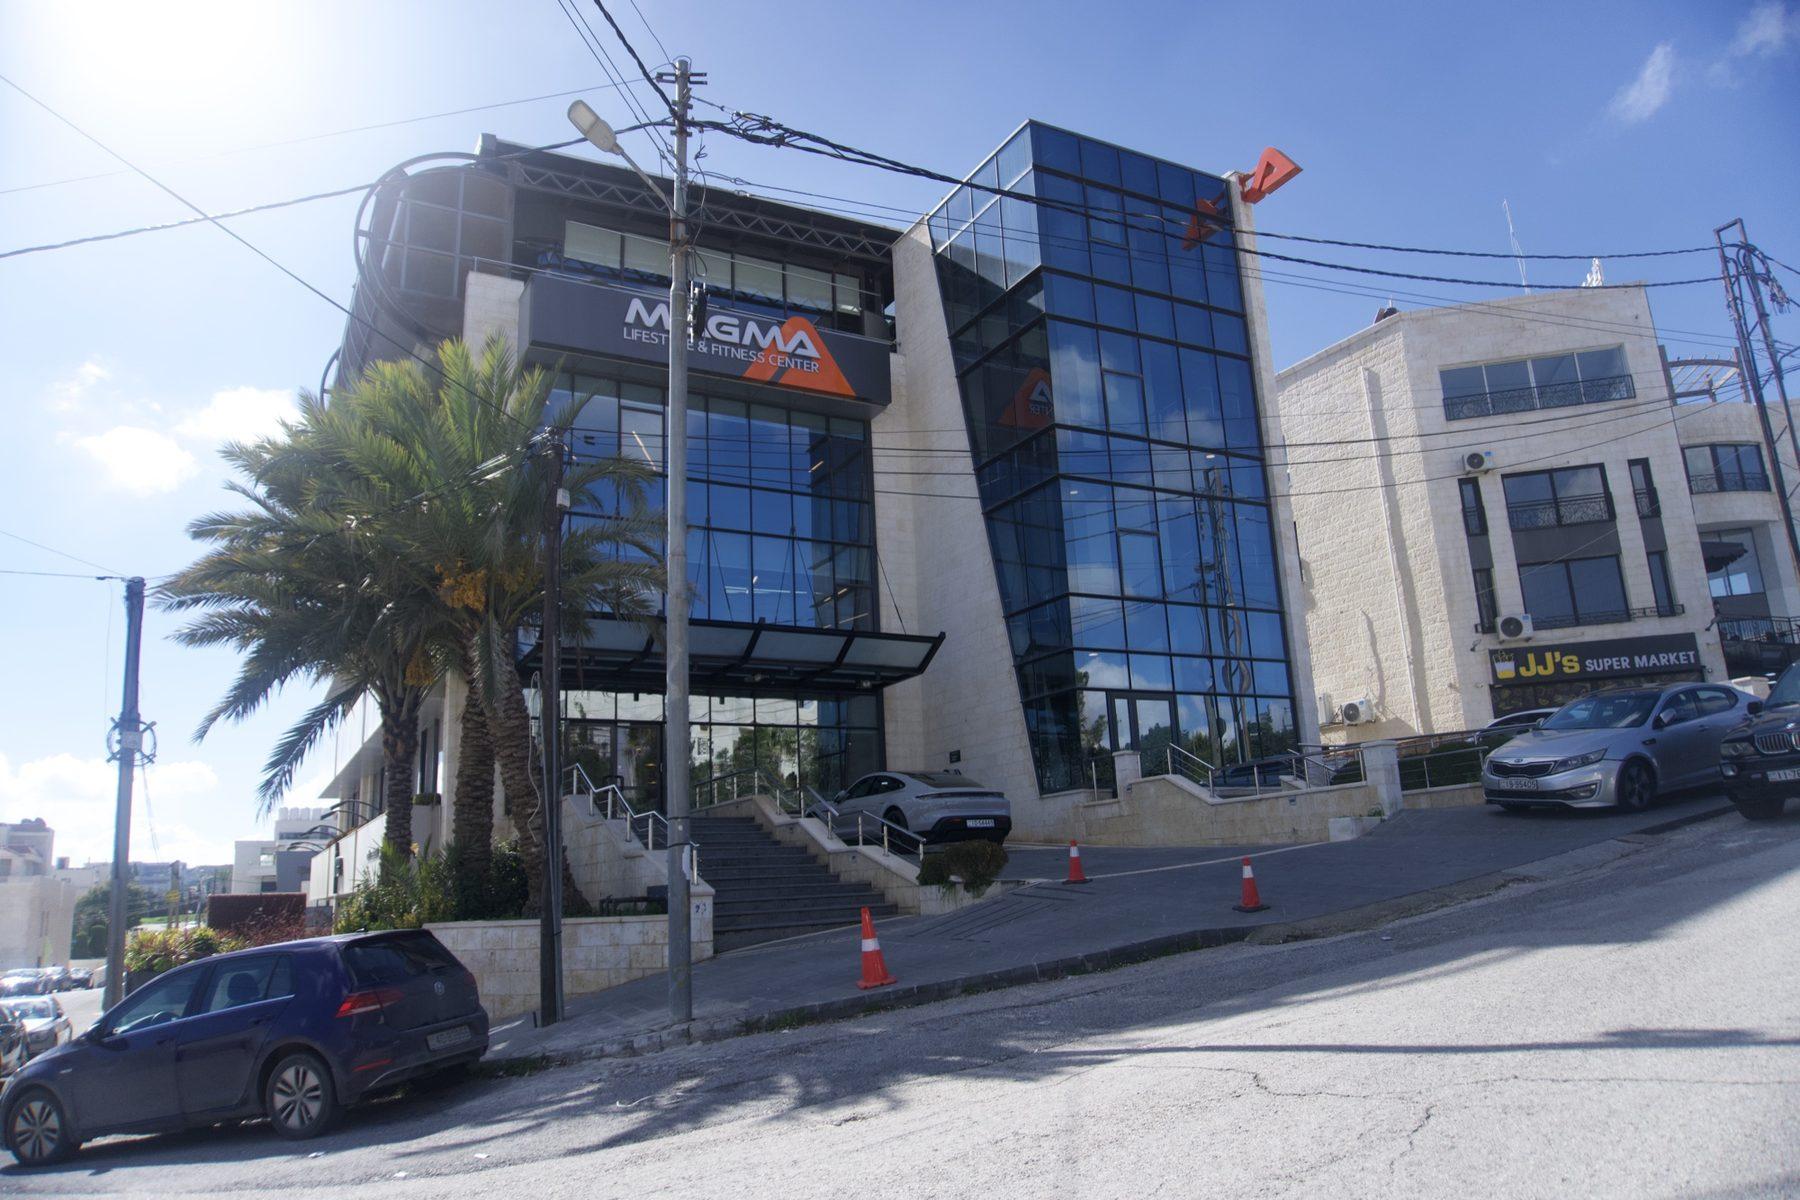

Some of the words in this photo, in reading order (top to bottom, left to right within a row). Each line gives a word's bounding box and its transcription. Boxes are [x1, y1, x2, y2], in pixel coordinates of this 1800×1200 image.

[623, 327, 694, 351] LIFESTE
[697, 340, 709, 354] &
[711, 343, 765, 364] FITNESS
[768, 353, 820, 373] CENTER
[624, 298, 821, 358] MGMA
[1585, 656, 1631, 672] SUPER
[1634, 651, 1696, 668] MARKET
